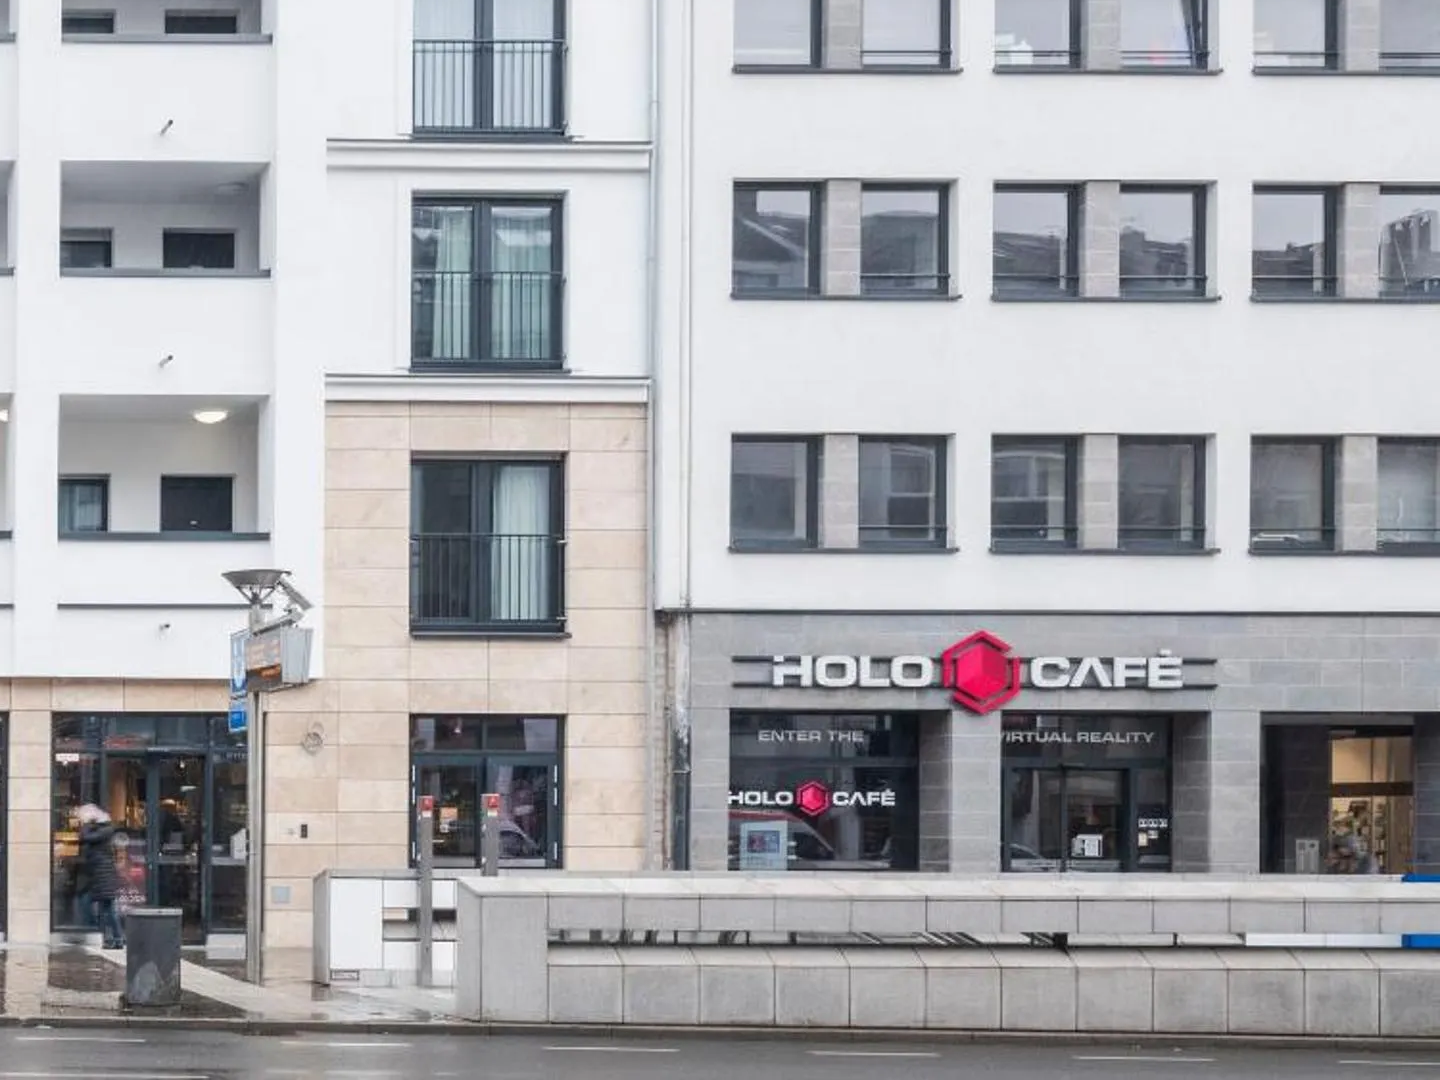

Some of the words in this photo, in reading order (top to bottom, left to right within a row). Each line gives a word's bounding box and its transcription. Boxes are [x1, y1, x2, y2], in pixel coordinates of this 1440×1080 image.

[772, 654, 934, 688] HOLO
[1029, 648, 1184, 689] CAFÉ
[758, 729, 822, 743] ENTER
[828, 730, 864, 743] THE
[1076, 731, 1155, 744] REALITY
[728, 791, 793, 806] HOLO
[832, 788, 896, 807] CAFÉ
